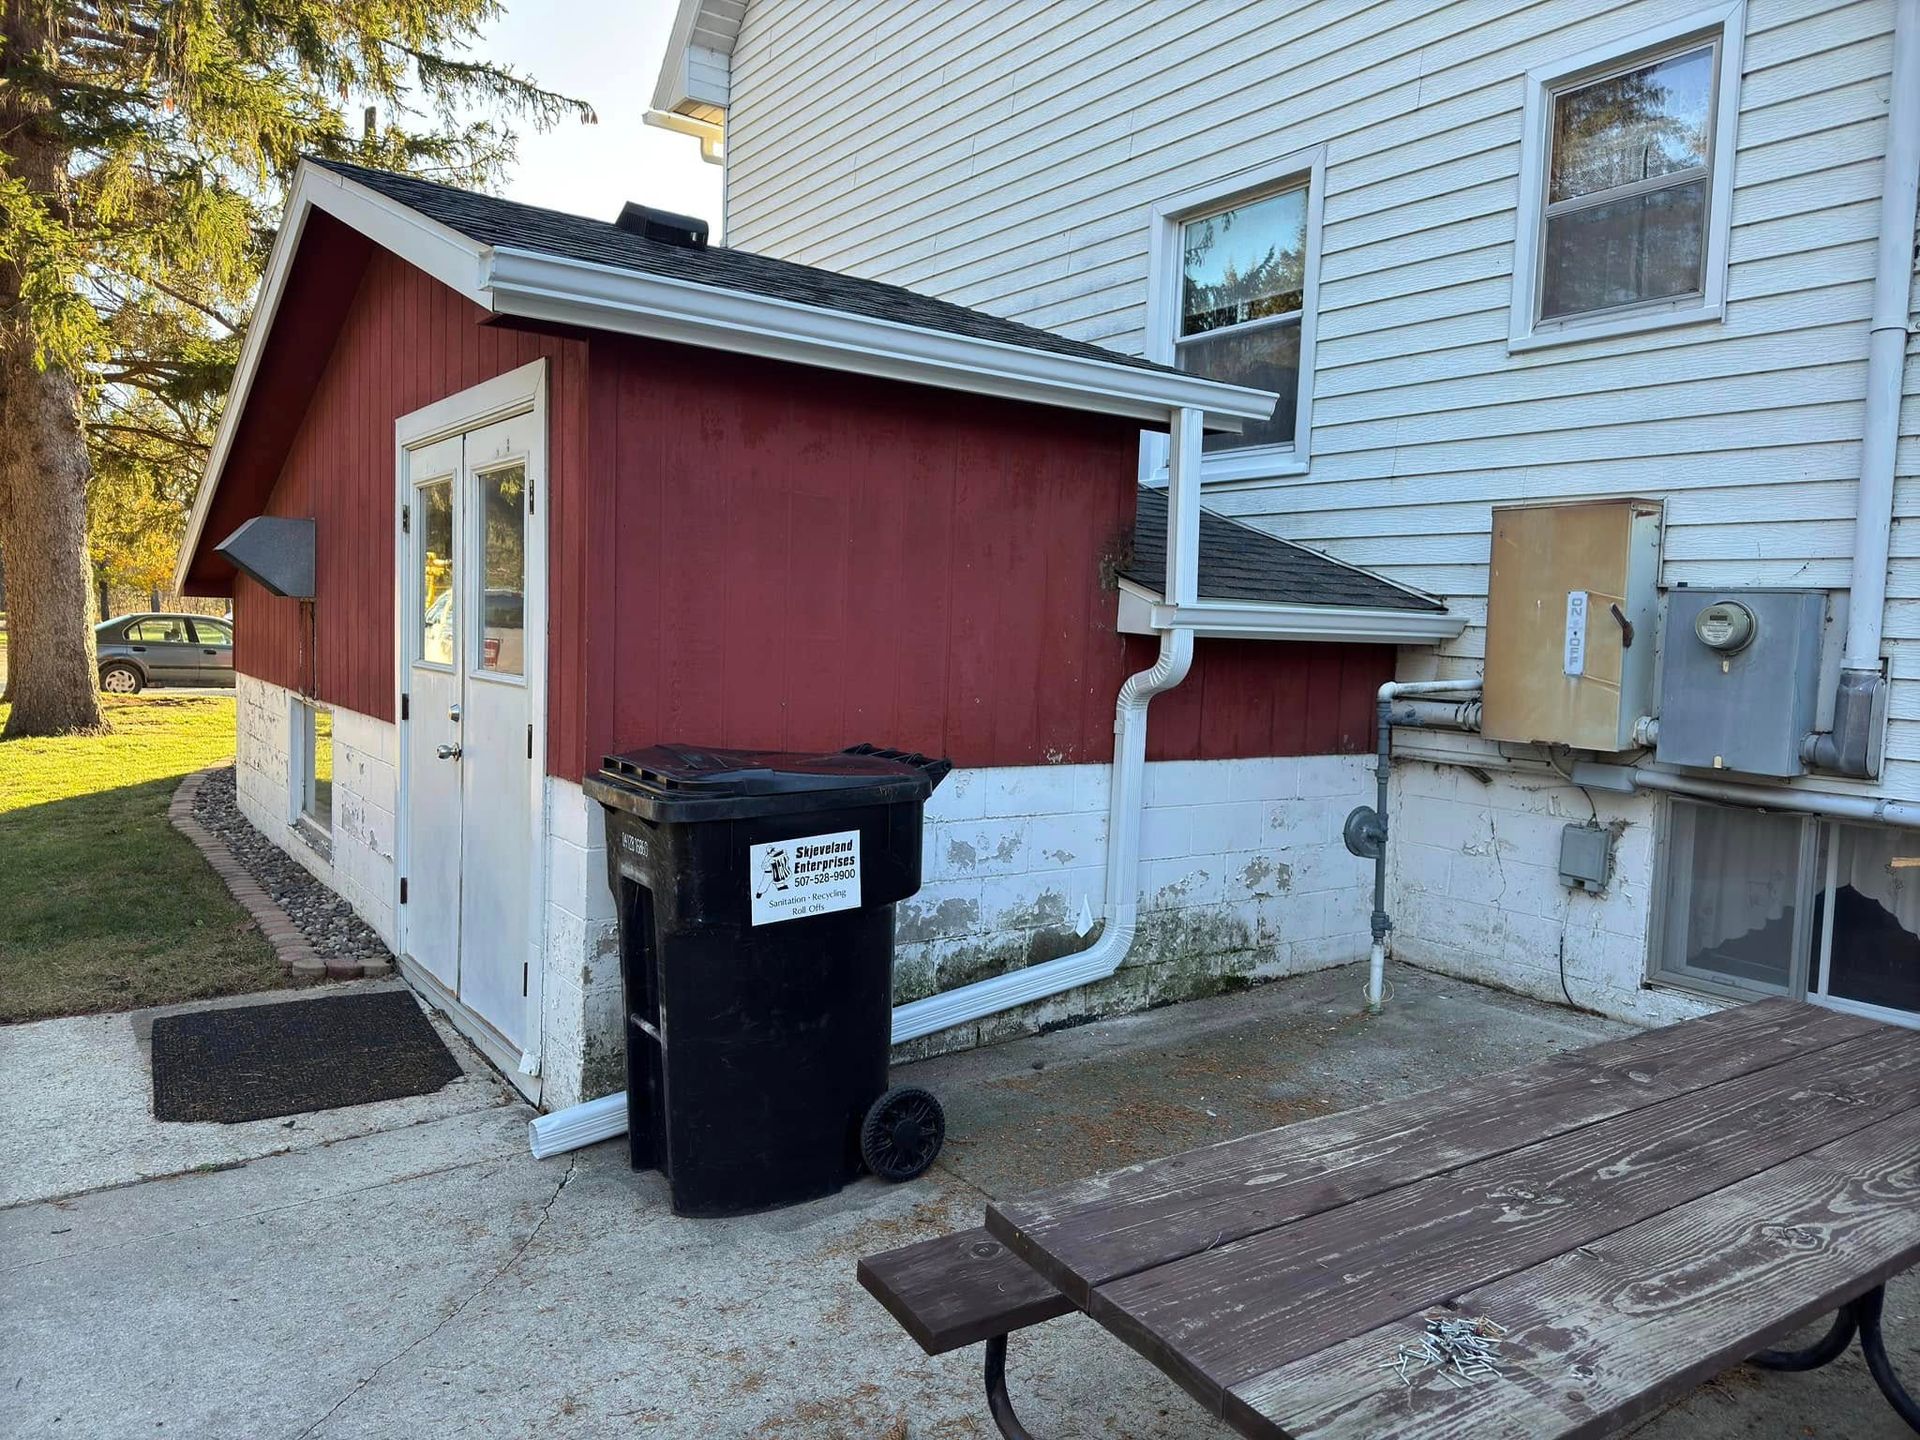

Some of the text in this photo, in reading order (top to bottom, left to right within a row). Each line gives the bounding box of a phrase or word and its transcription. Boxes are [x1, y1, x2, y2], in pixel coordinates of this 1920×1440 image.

[1571, 598, 1583, 616] ON
[1569, 638, 1580, 666] OFF
[795, 839, 853, 859] Skjeveland
[794, 856, 855, 874] Enterprises
[794, 868, 856, 887] 507-528-9900
[768, 888, 847, 908] Sanitation Recycling
[792, 903, 825, 915] Roll Offs
